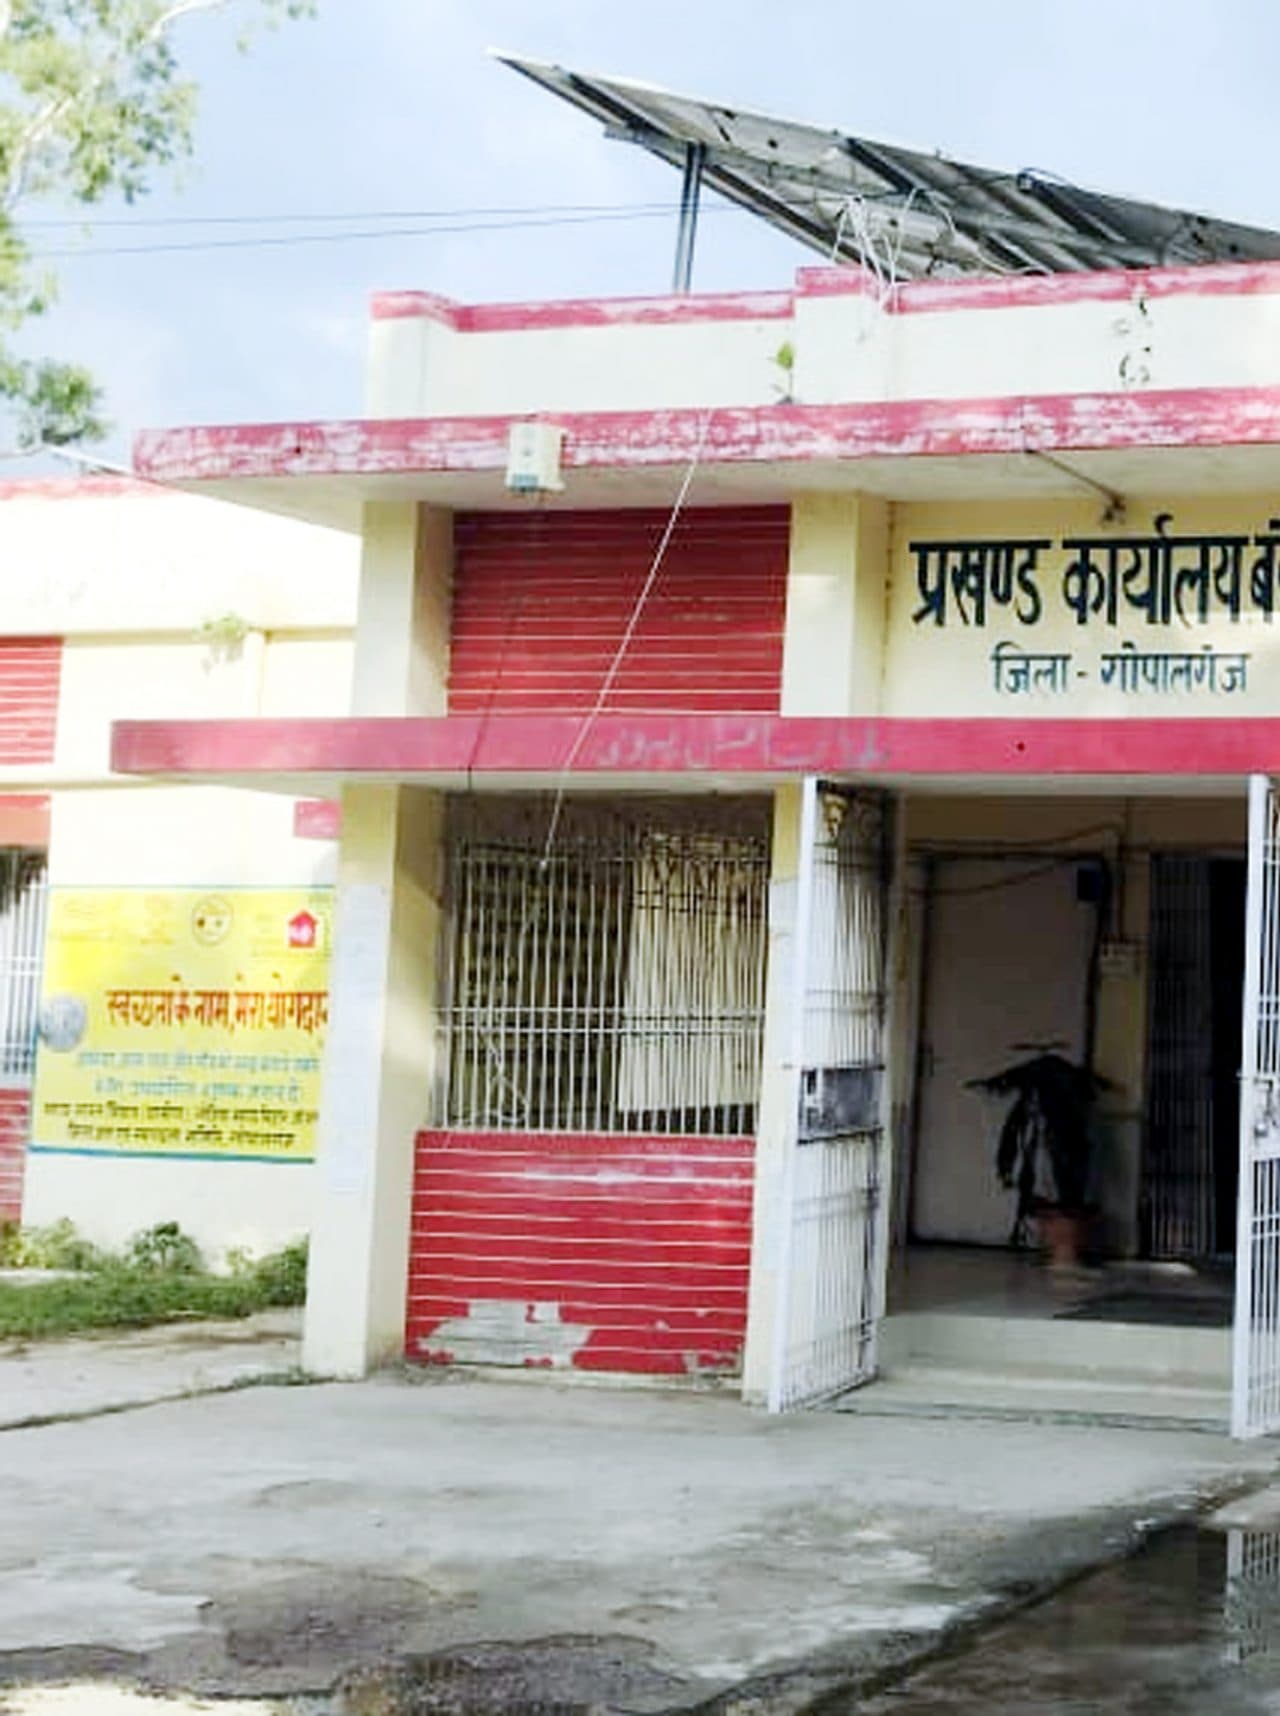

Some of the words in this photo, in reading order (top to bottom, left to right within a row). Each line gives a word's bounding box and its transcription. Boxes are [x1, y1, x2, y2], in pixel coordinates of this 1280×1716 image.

[909, 539, 1051, 626] प्रखण्ड
[1062, 514, 1249, 628] कार्यालय
[991, 641, 1072, 693] जिला
[1100, 641, 1252, 693] गोपालगंज
